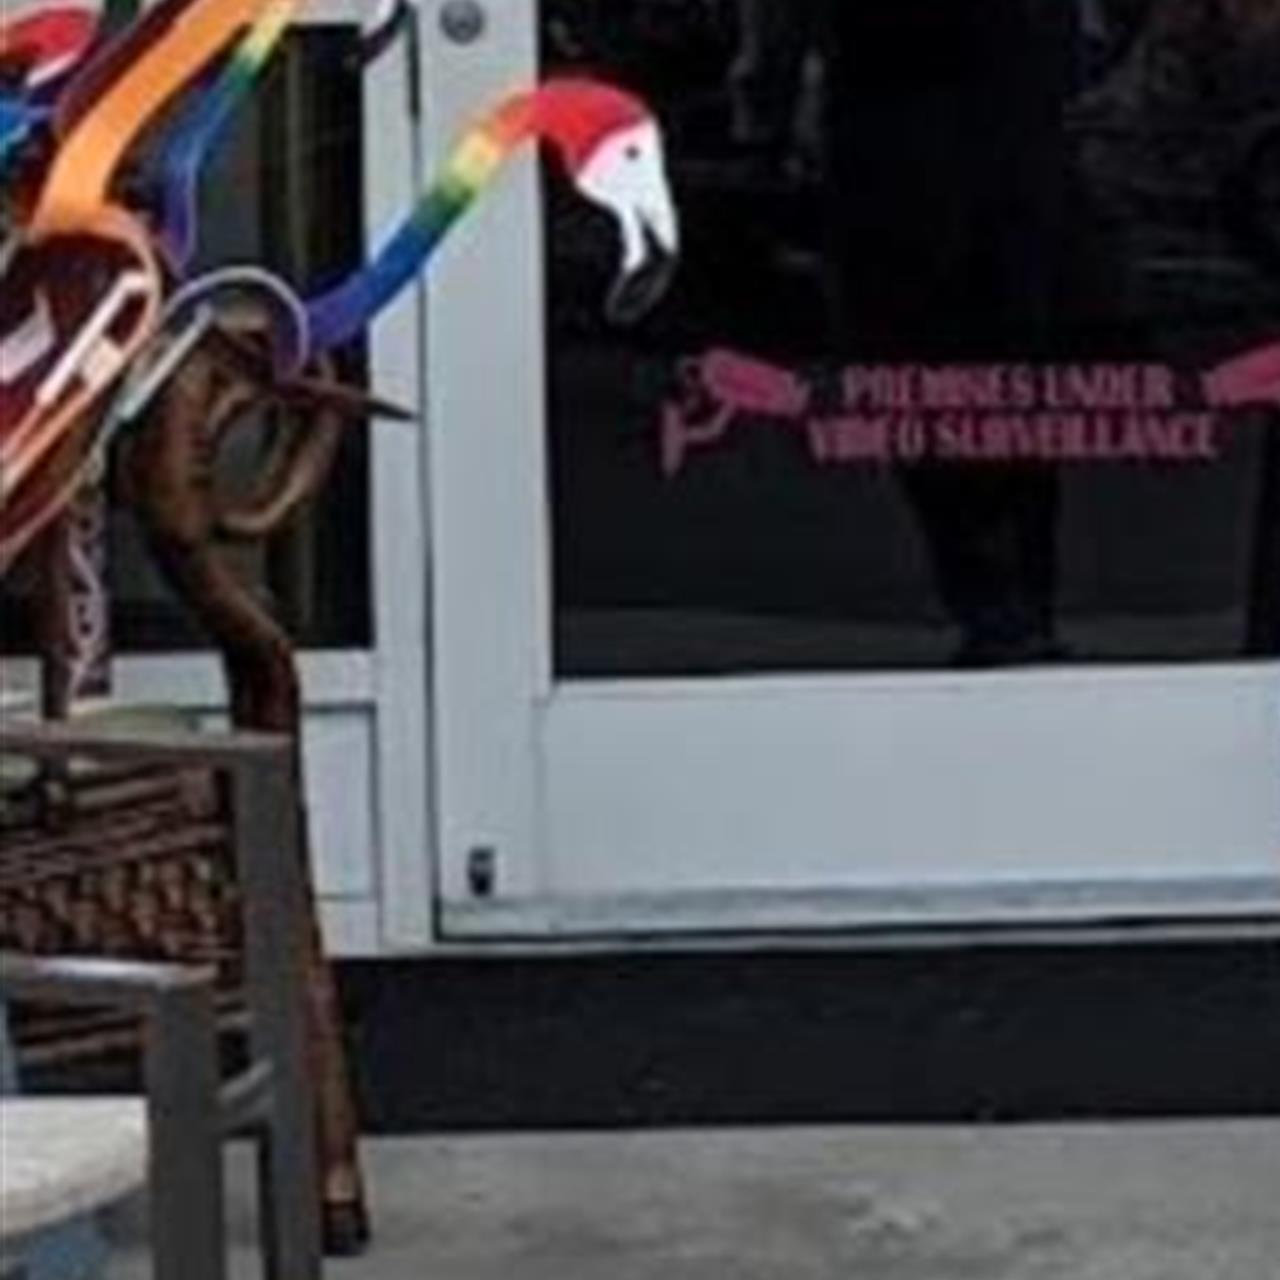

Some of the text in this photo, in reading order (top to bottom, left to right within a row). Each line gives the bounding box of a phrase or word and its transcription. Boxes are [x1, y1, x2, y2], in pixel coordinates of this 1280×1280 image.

[842, 363, 1174, 409] PREMISES UNDER
[934, 412, 1216, 460] SURVEILLANCE
